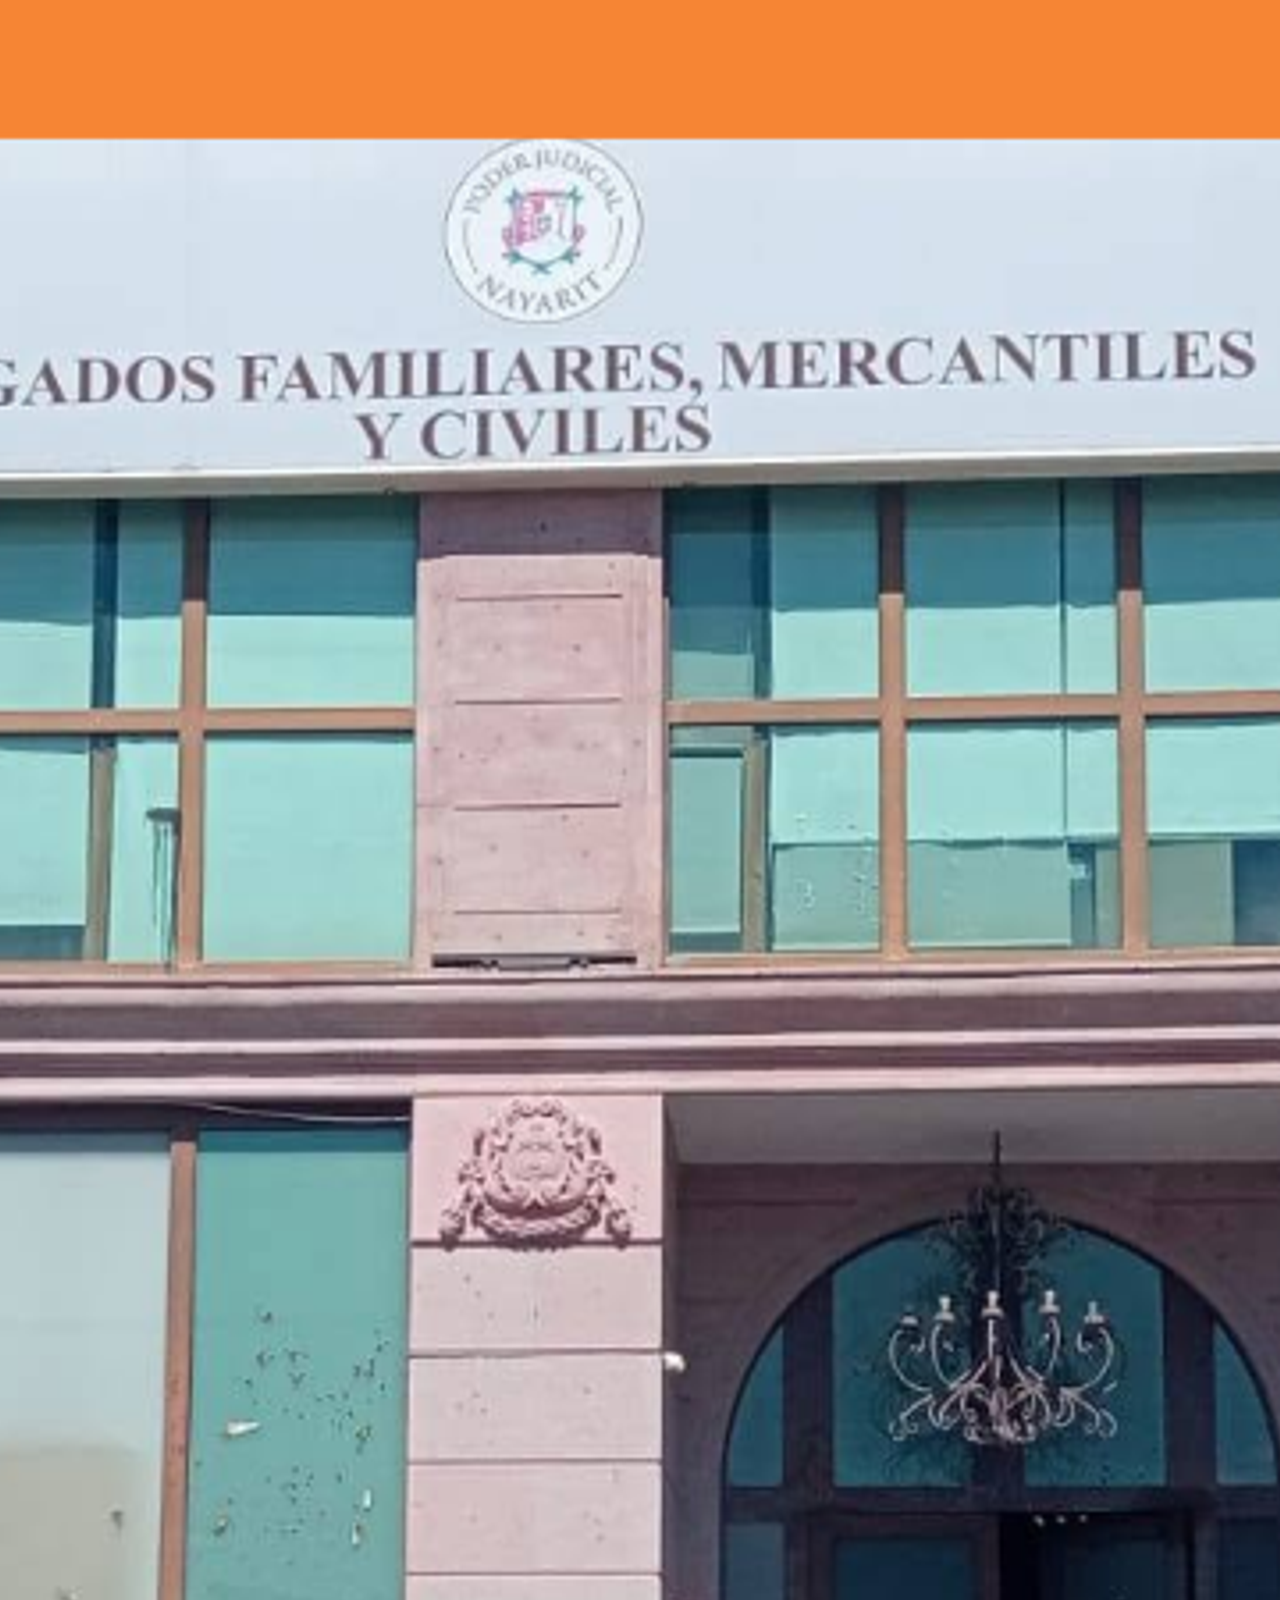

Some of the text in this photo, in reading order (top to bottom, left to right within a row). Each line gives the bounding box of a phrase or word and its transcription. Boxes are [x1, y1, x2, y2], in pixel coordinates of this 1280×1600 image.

[463, 149, 624, 215] PODER JUDICIAL
[477, 270, 601, 315] NAYARIT
[236, 341, 703, 401] FAMILIARES,
[717, 328, 1258, 391] MERCANTILES
[355, 403, 712, 461] Y CIVILES
